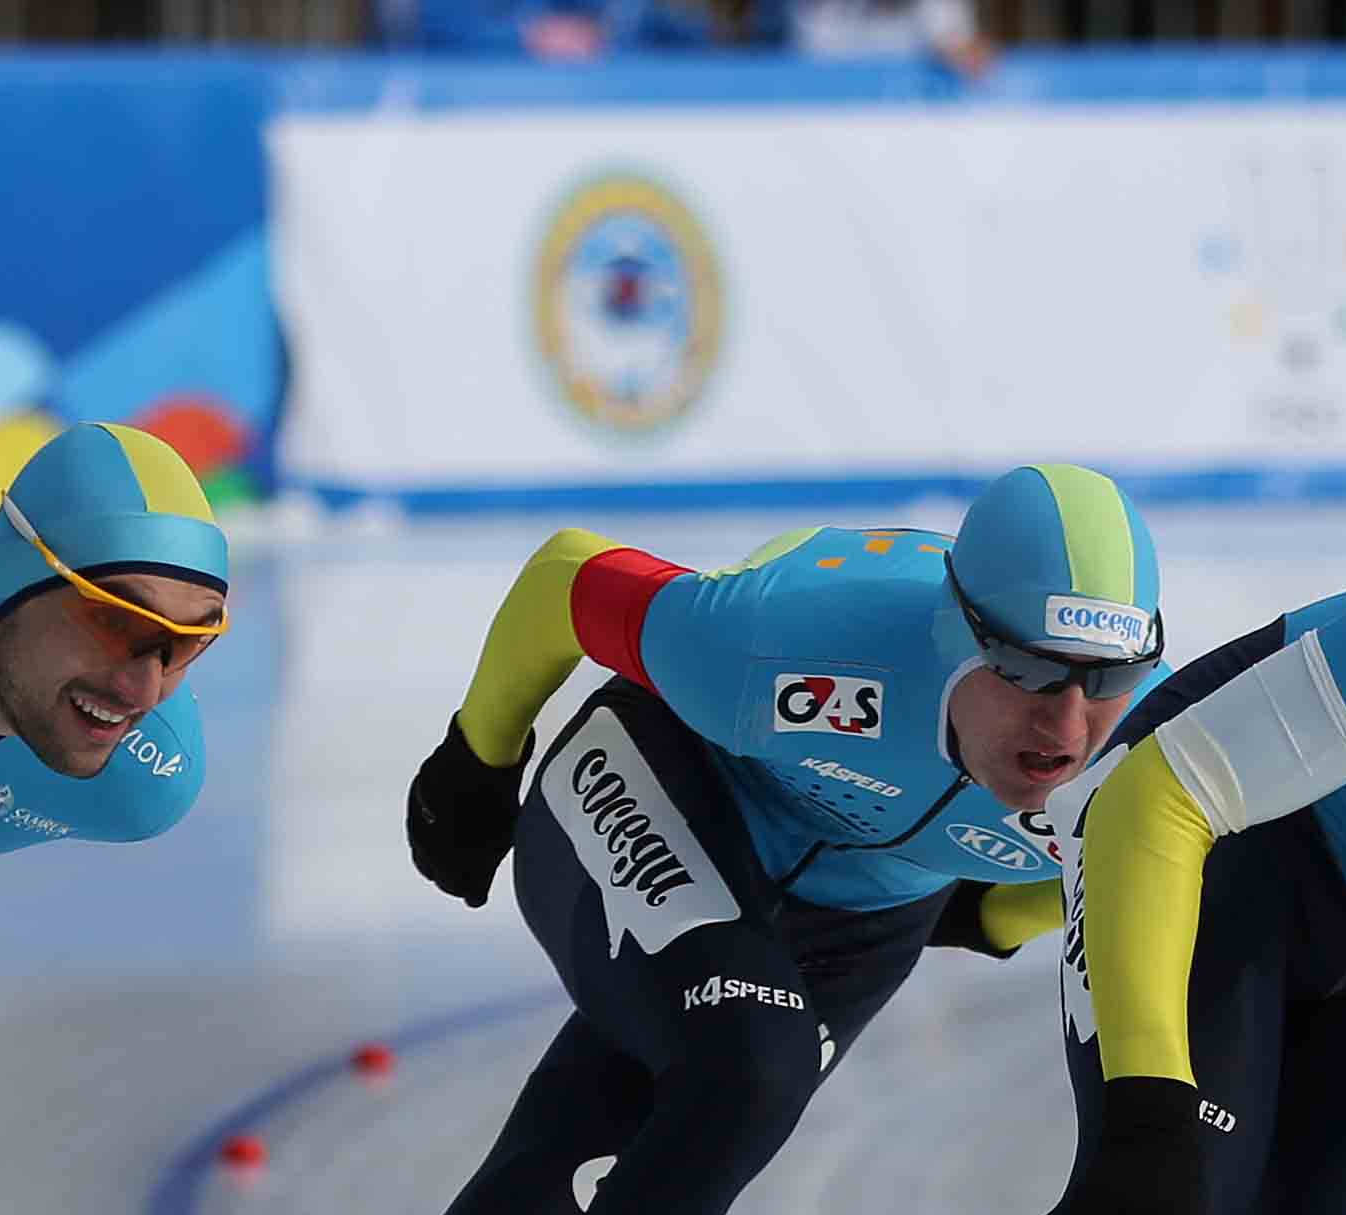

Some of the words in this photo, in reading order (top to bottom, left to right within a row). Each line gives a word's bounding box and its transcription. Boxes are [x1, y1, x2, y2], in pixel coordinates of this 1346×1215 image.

[777, 677, 879, 733] G4S
[798, 757, 903, 798] K4SPEED
[959, 828, 1028, 867] KIA
[684, 975, 805, 1010] K4SPEED
